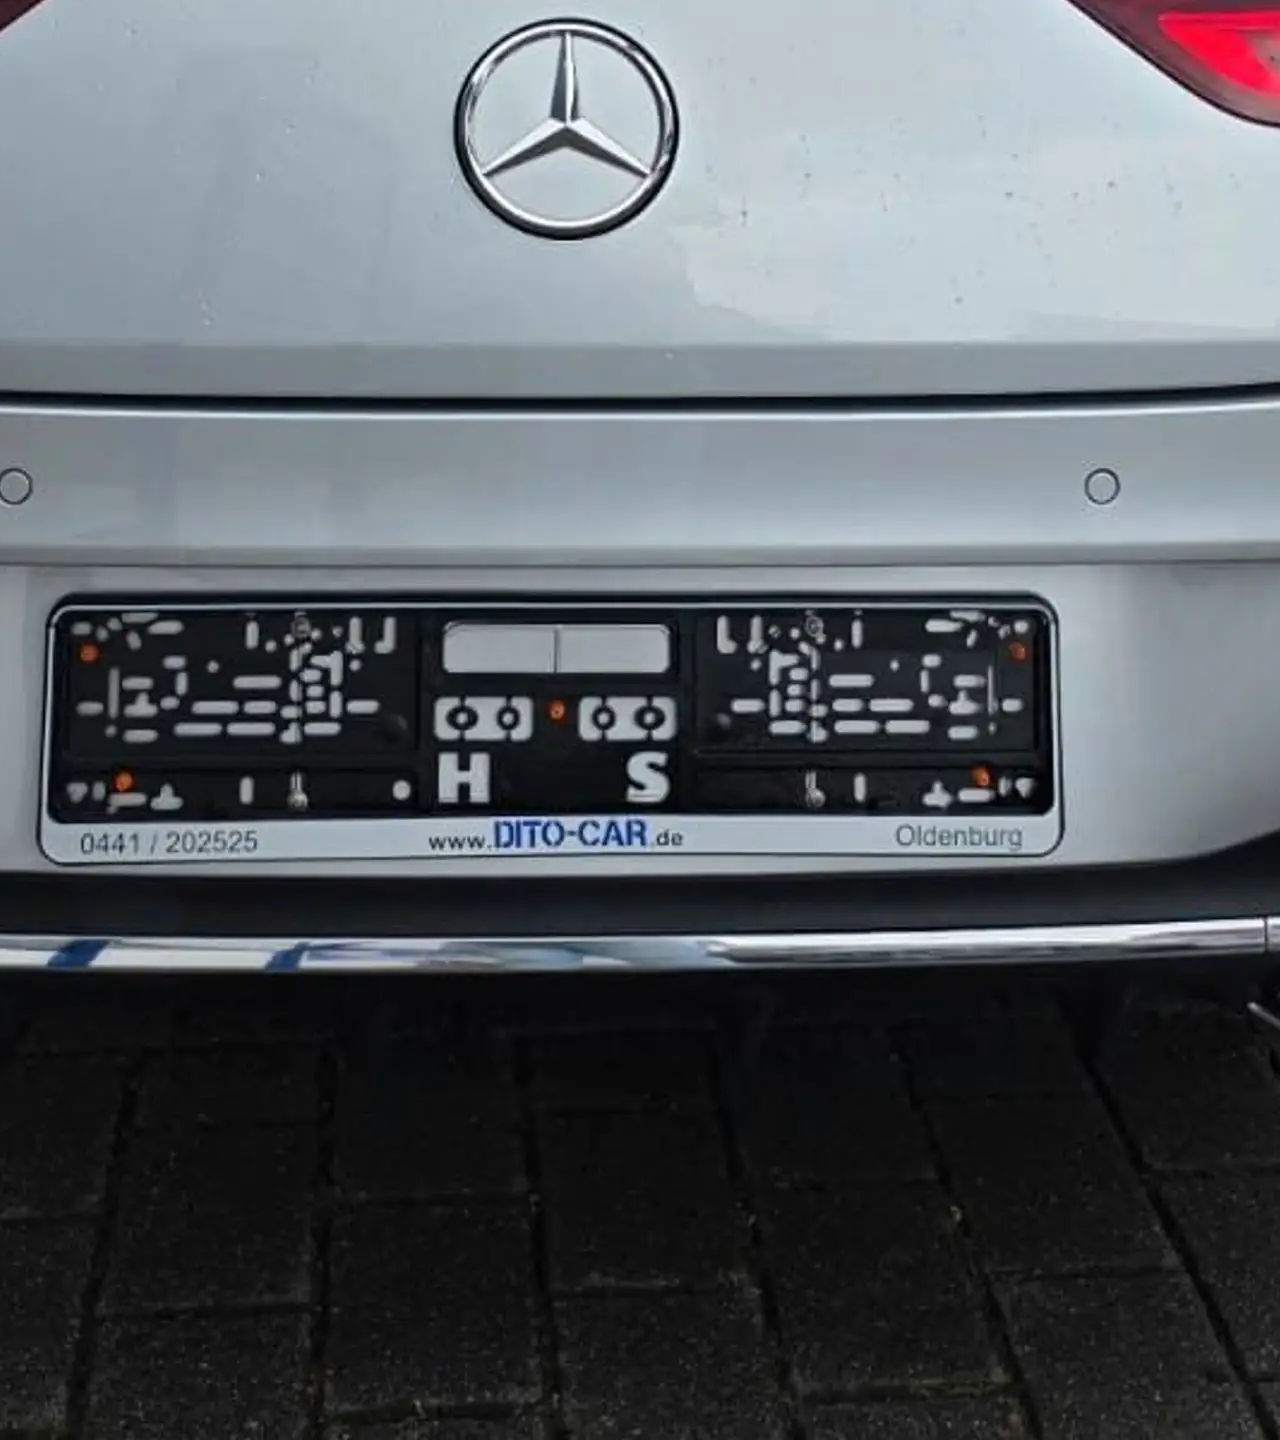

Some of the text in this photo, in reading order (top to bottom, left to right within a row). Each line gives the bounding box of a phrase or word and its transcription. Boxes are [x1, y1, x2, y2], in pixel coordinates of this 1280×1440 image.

[438, 751, 669, 803] H S
[80, 832, 139, 855] 0441
[165, 829, 259, 854] 202525
[428, 818, 684, 850] www.DITO-CAR.de
[895, 823, 1023, 852] Oldenburg
